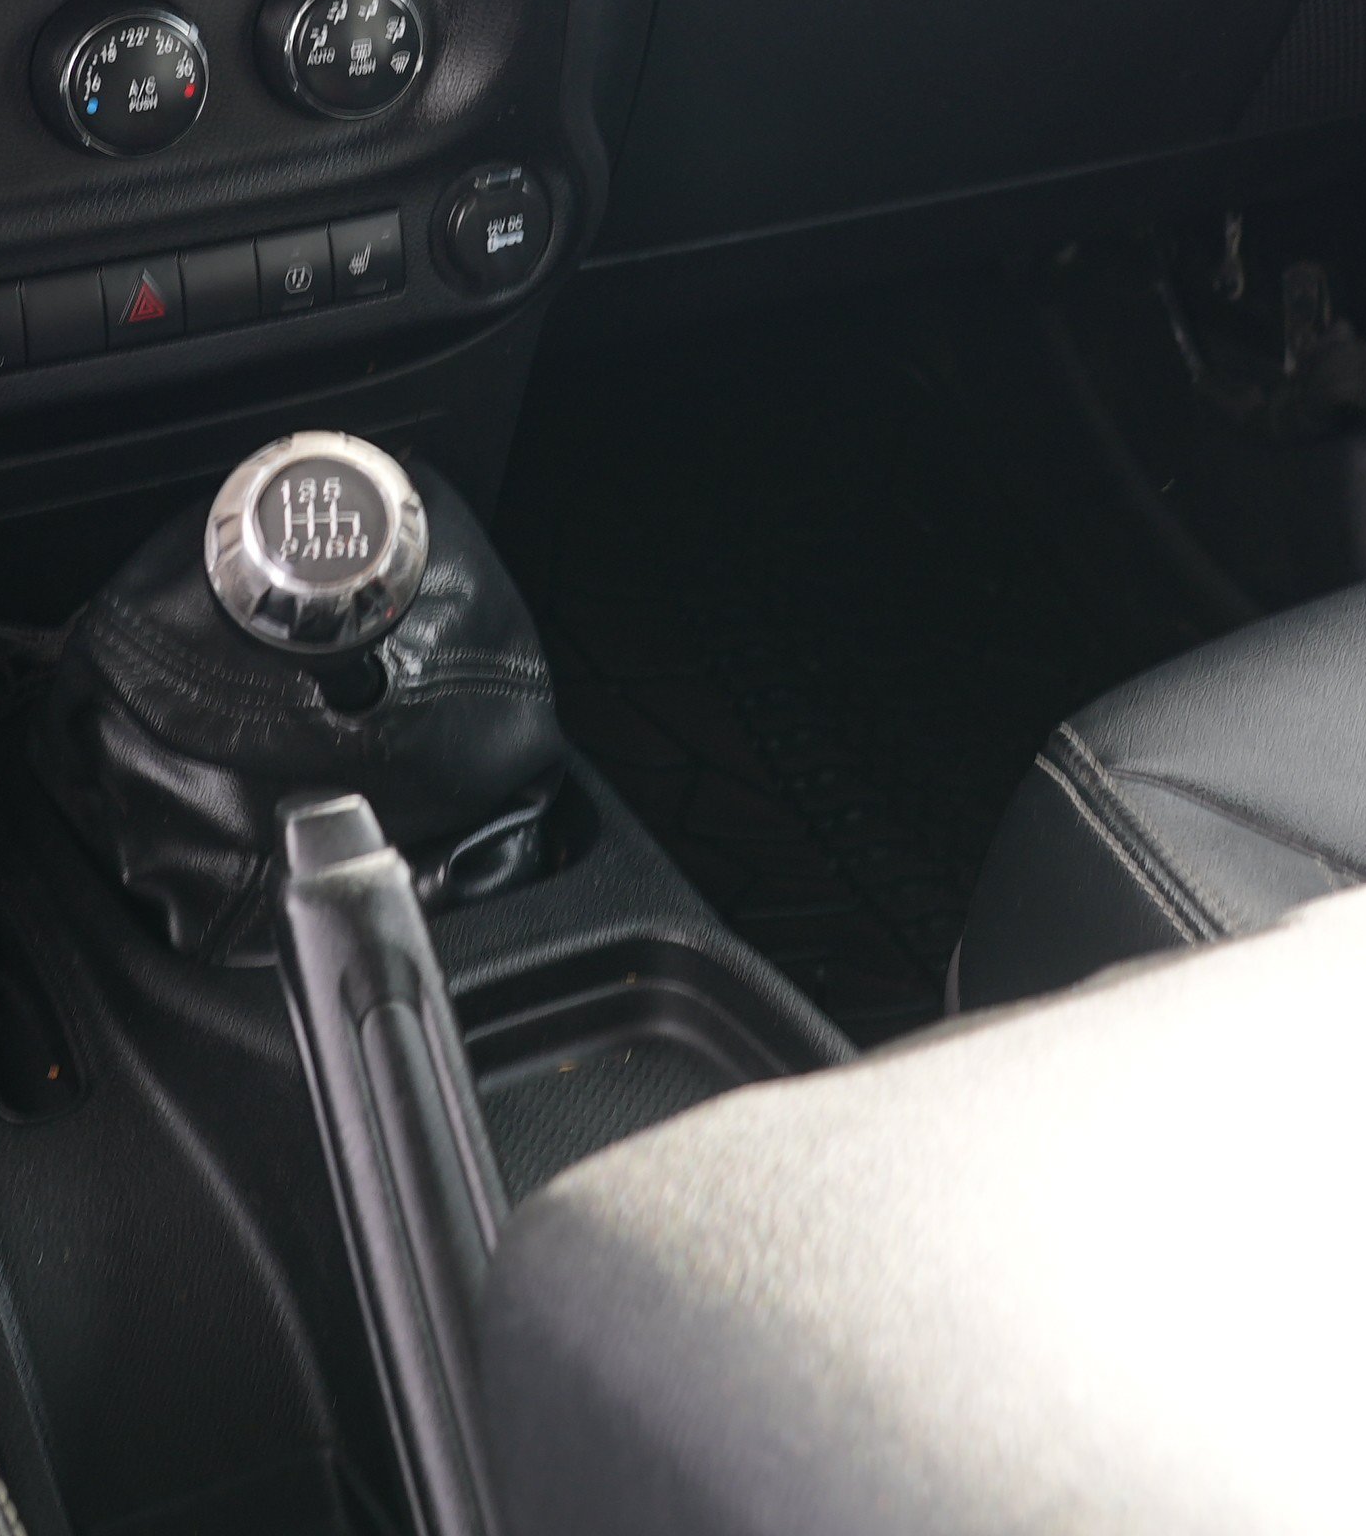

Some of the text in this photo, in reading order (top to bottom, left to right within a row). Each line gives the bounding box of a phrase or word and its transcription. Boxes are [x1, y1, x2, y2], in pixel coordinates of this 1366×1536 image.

[307, 46, 336, 66] AUTO
[349, 57, 377, 77] PUSH
[128, 92, 158, 113] PUSH
[281, 478, 291, 505] 1
[302, 534, 322, 561] 4
